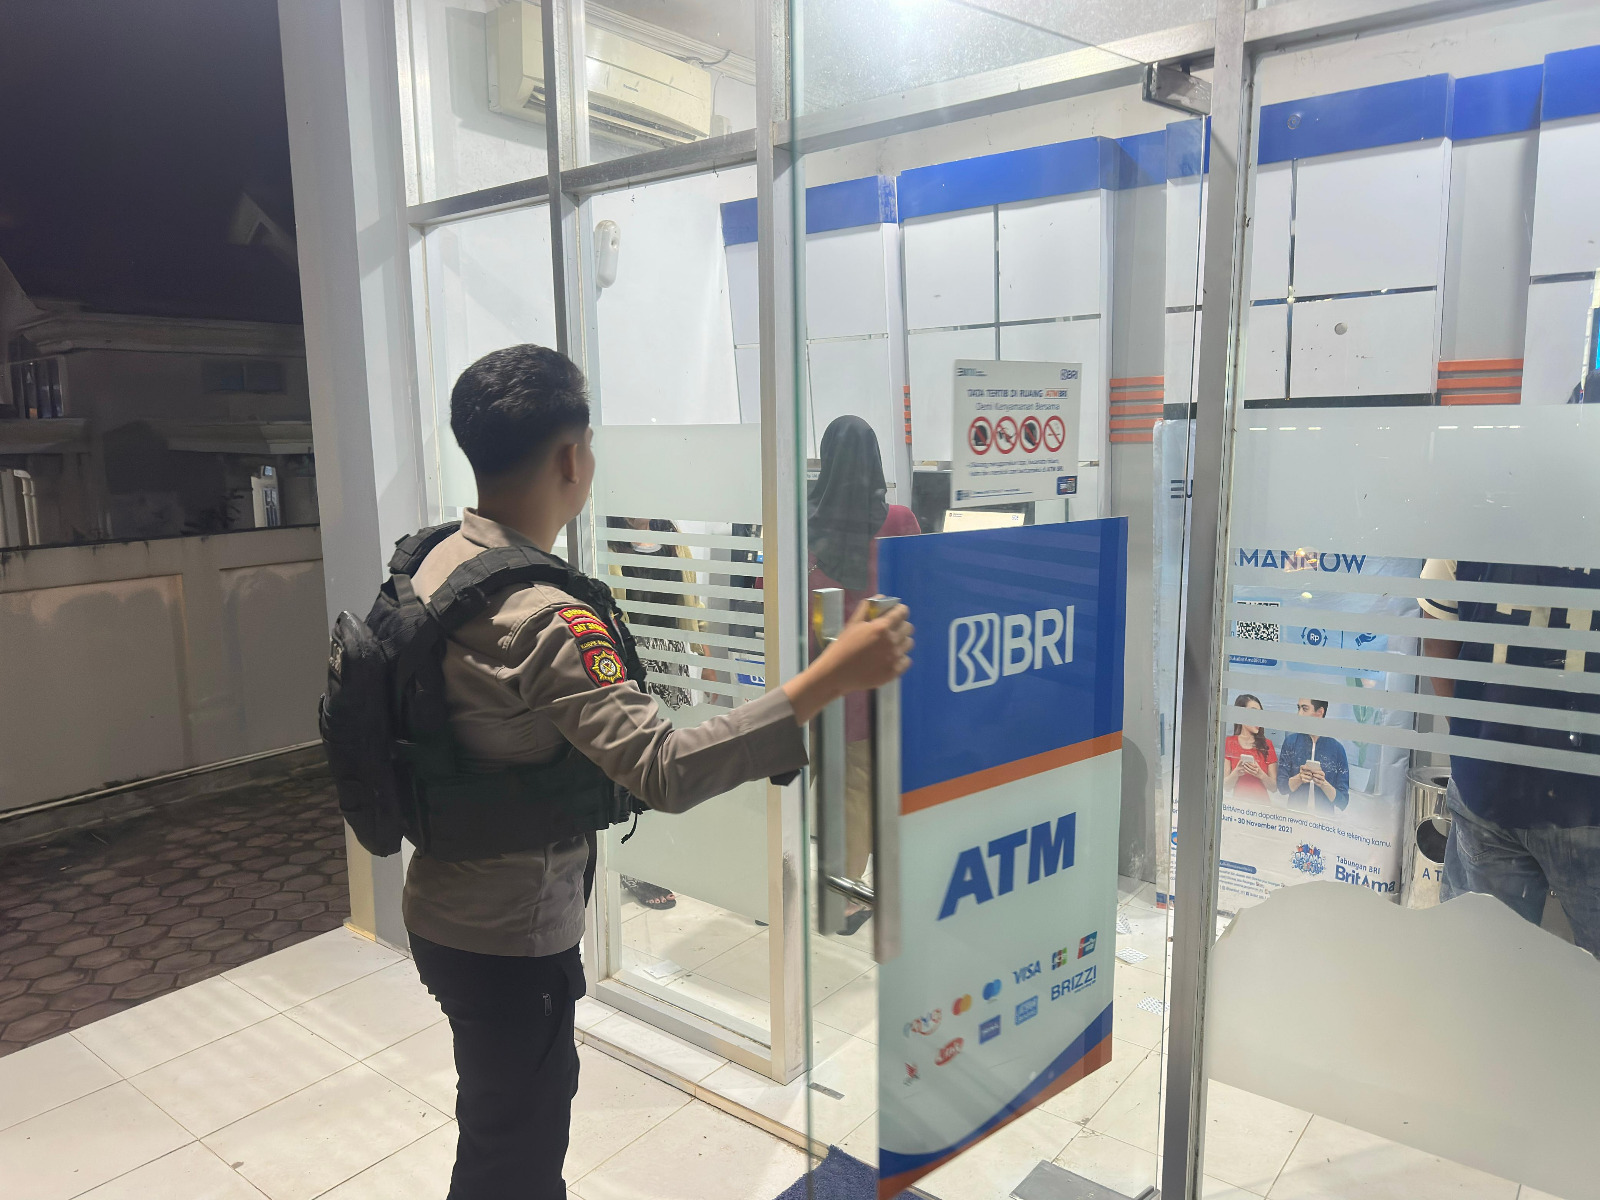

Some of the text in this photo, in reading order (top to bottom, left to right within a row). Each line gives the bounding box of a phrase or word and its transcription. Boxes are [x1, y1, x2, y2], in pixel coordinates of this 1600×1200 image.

[1235, 548, 1366, 574] MANNOW
[1002, 605, 1075, 677] BRI
[1237, 817, 1246, 825] 30
[1246, 820, 1278, 830] November
[1278, 825, 1293, 833] 2021
[1245, 809, 1258, 817] dan
[1258, 811, 1287, 823] dapatkan
[1287, 817, 1308, 827] reward
[1308, 821, 1336, 834] cashback
[1337, 827, 1346, 837] ke
[1346, 832, 1371, 846] rekening
[936, 812, 1076, 921] ATM
[1335, 864, 1396, 893] BritAma
[1336, 855, 1367, 871] Tabungan
[1368, 865, 1381, 875] BRI
[1012, 960, 1041, 984] VISA
[1051, 965, 1097, 1001] BRIZZI
